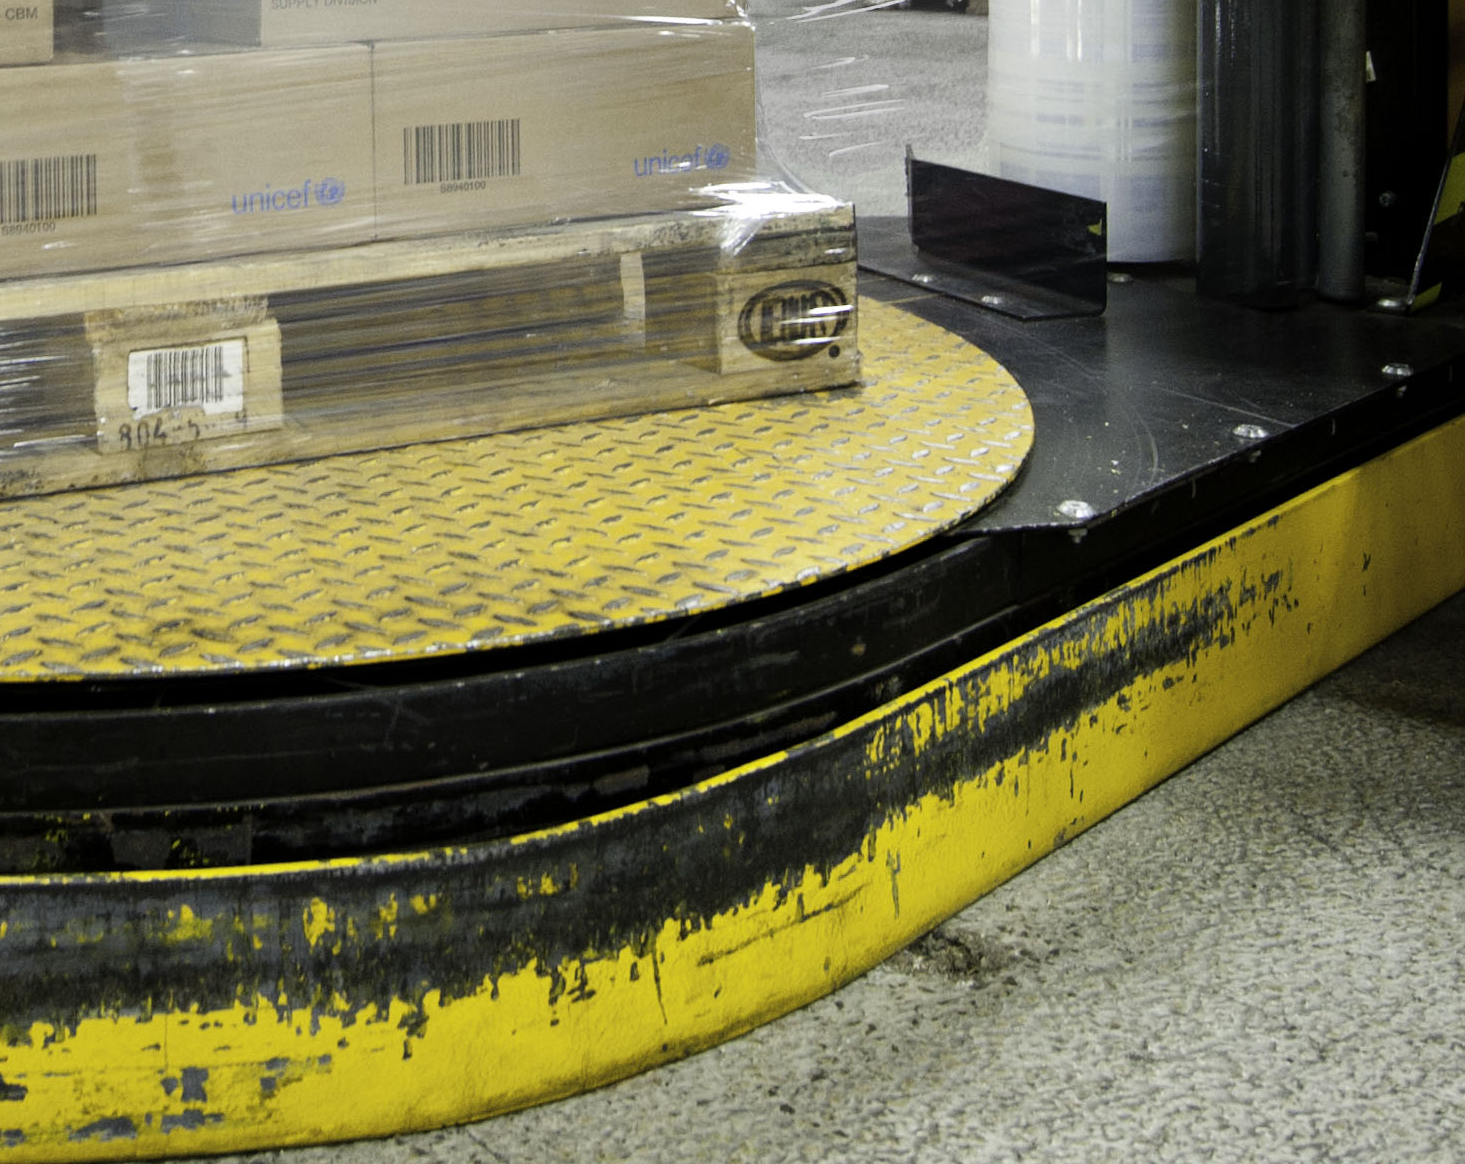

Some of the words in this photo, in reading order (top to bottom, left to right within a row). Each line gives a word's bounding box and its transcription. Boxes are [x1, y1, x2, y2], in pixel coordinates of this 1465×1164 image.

[5, 7, 38, 21] CBM
[634, 144, 702, 176] unicef
[232, 179, 312, 214] unicef
